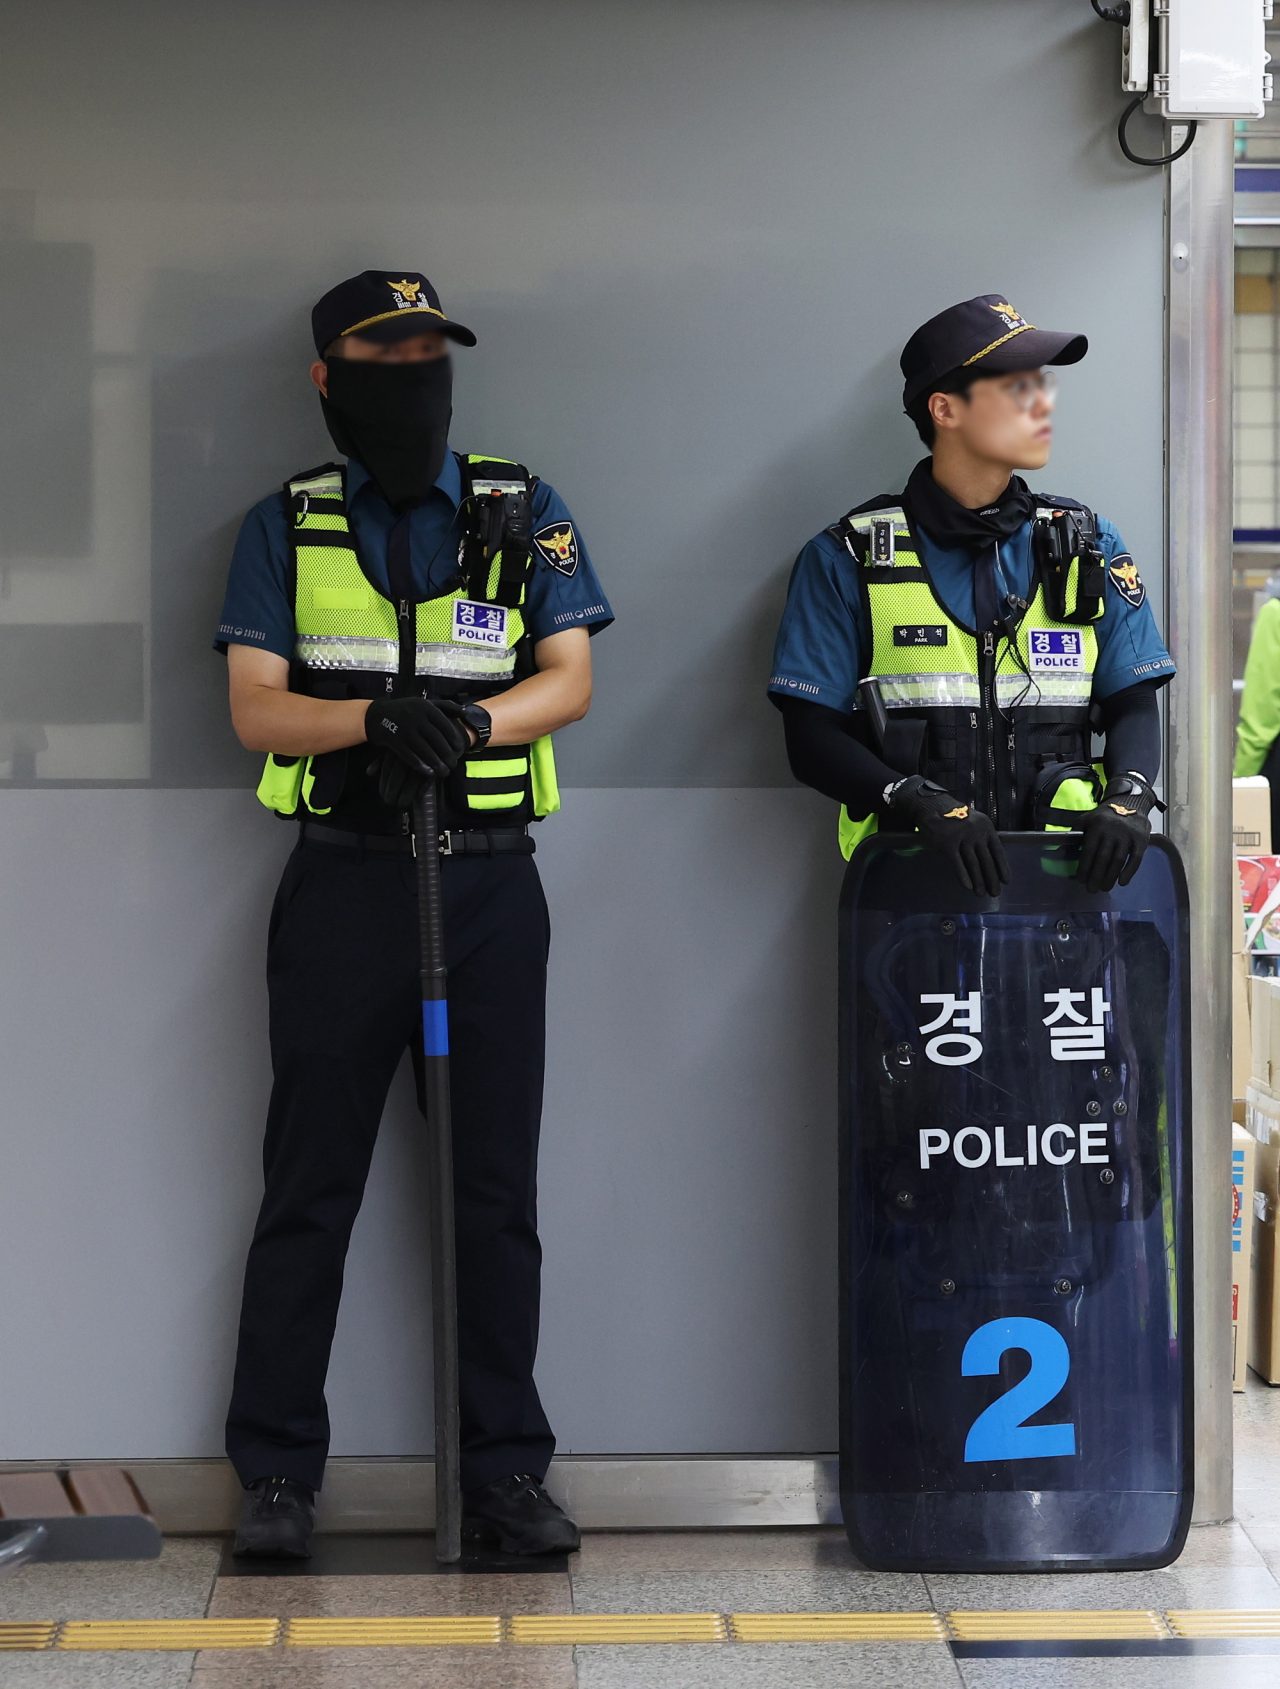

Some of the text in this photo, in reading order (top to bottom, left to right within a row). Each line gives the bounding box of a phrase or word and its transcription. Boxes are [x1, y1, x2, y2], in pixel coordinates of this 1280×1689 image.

[458, 628, 501, 643] POLICE
[1035, 657, 1079, 667] POLICE
[919, 1122, 1110, 1170] POLICE
[961, 1316, 1077, 1463] 2
